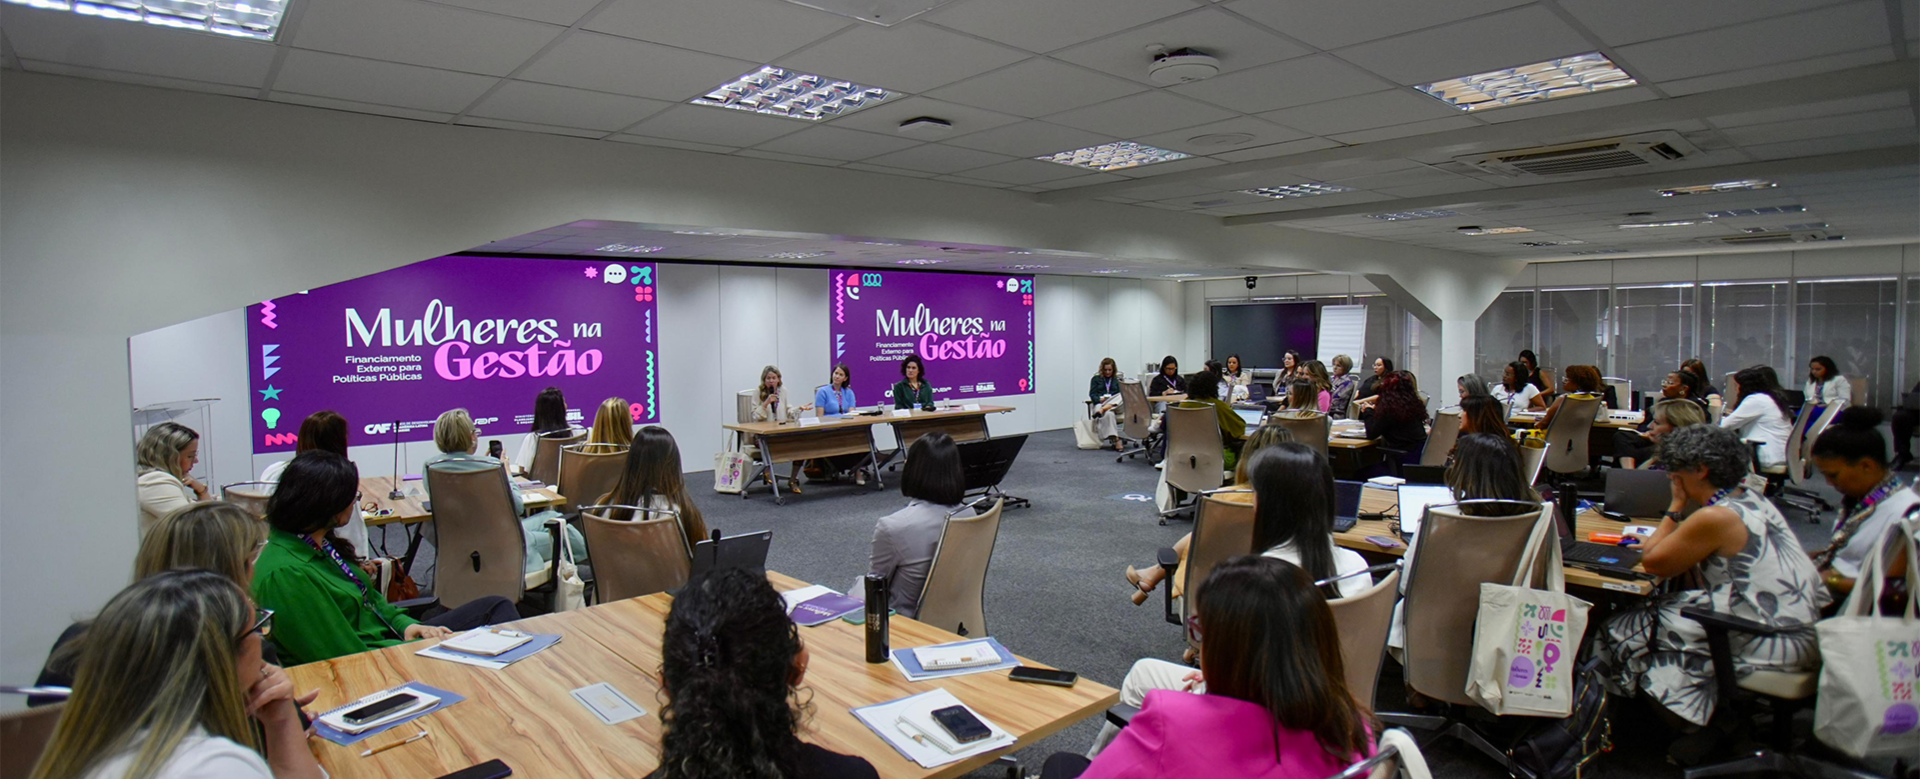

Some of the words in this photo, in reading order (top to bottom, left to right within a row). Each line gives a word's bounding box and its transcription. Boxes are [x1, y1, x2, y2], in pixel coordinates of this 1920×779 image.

[345, 299, 559, 347] Mulheres
[573, 322, 602, 338] na
[876, 303, 983, 337] Mulheres
[990, 320, 1006, 331] na
[919, 332, 1006, 361] Gestão
[345, 354, 422, 364] Financiamento
[357, 365, 397, 373] Externo
[399, 364, 422, 373] para
[434, 340, 603, 381] Gestão
[332, 374, 377, 384] Políticas
[379, 373, 422, 381] Públicas
[364, 422, 392, 435] CAF
